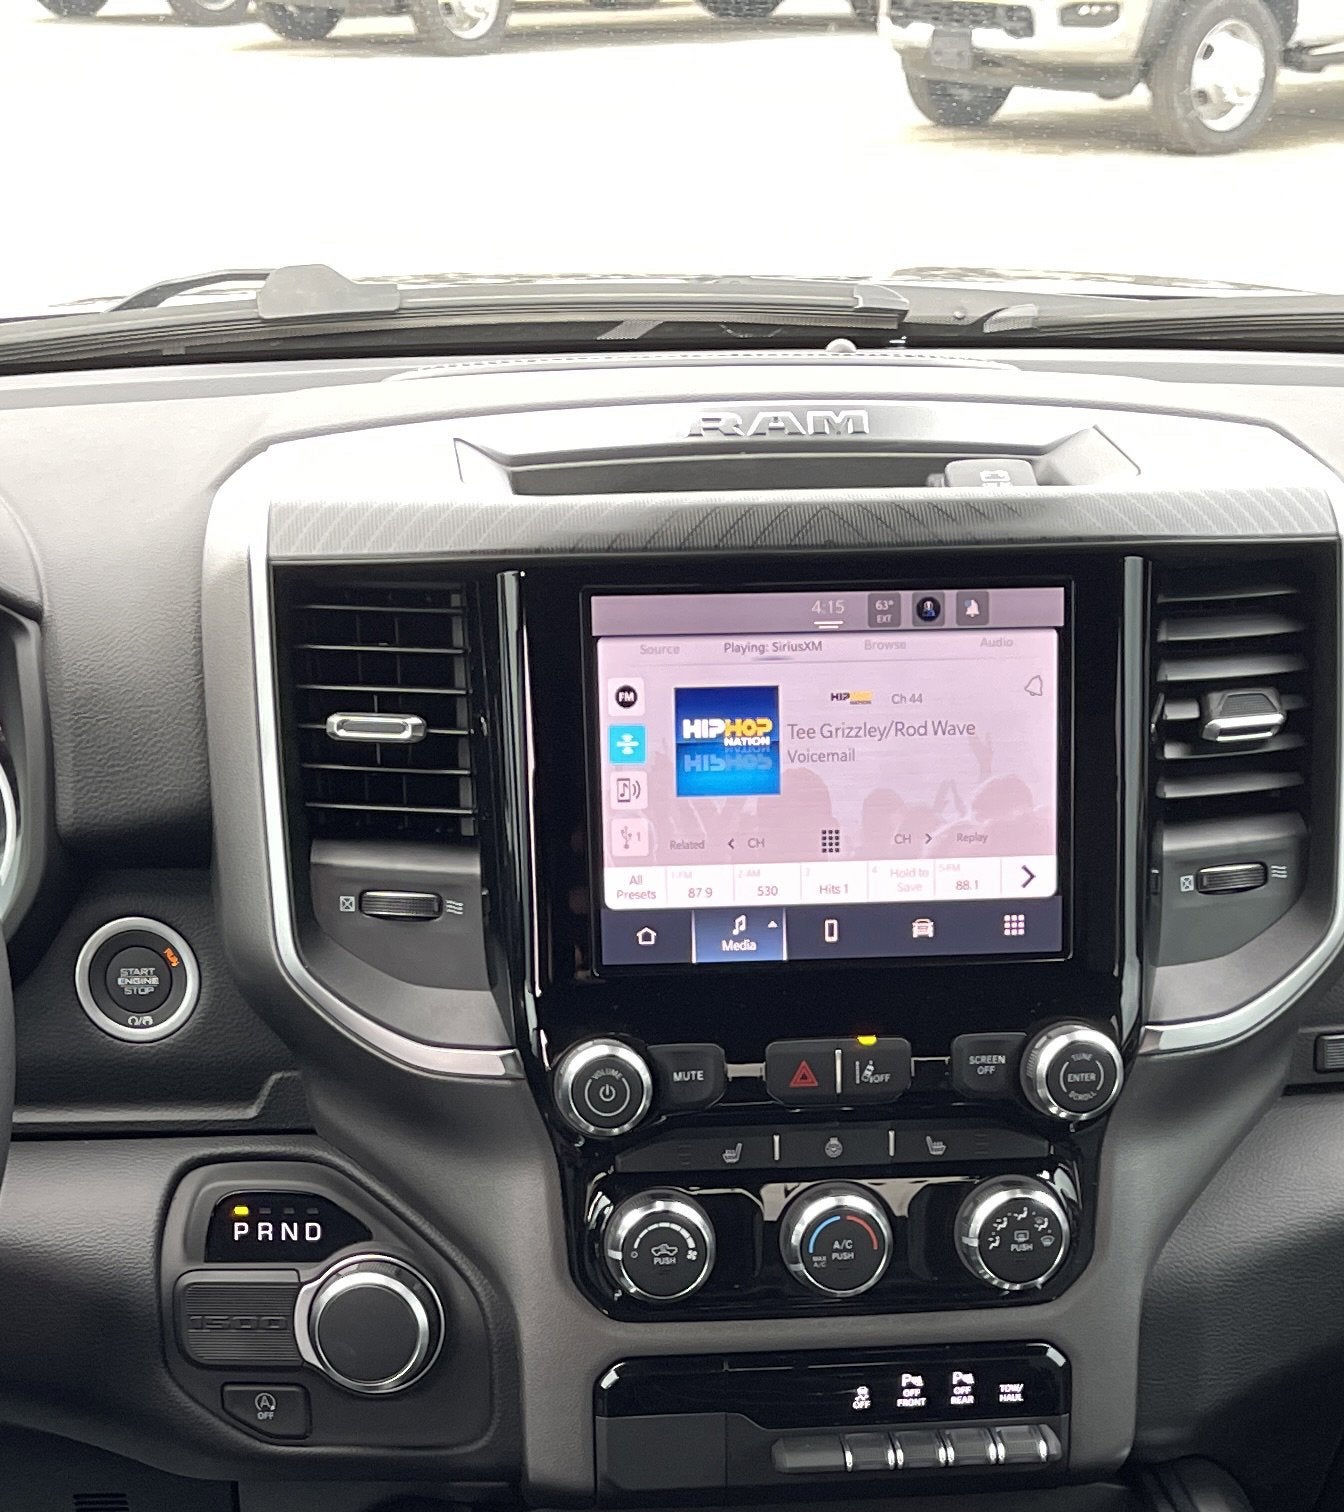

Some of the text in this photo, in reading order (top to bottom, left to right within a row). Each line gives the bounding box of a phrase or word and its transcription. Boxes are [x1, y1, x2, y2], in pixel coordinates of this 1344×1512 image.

[687, 409, 871, 437] RAM
[811, 599, 845, 615] 4:15
[876, 614, 892, 624] EXT
[723, 640, 824, 656] Playing: SiriusXM
[864, 639, 907, 651] Browse
[980, 636, 1014, 649] Audio
[639, 643, 681, 656] Source
[618, 690, 637, 702] FM
[891, 692, 924, 705] Ch 44
[787, 719, 977, 742] Tee Grizzley/Rod Wave
[723, 735, 771, 747] NATION
[787, 748, 856, 764] Voicemail
[747, 837, 766, 849] CH
[894, 833, 912, 845] CH
[956, 832, 988, 844] Replay
[669, 839, 706, 851] Related
[889, 867, 930, 879] Hold to
[628, 875, 644, 886] All
[896, 881, 923, 892] Save
[955, 879, 979, 891] 88.1
[616, 888, 657, 901] Presets
[757, 885, 779, 897] 530
[819, 883, 841, 895] Hits
[721, 938, 757, 952] Media
[119, 967, 156, 978] START
[117, 977, 160, 986] ENGINE
[123, 986, 155, 996] STOP
[968, 1055, 1006, 1066] SCREEN
[591, 1068, 623, 1081] VOLUME
[672, 1070, 705, 1082] MUTE
[976, 1065, 996, 1075] OFF
[1067, 1072, 1097, 1083] ENTER
[1067, 1090, 1098, 1101] SCROLL
[833, 1239, 853, 1250] A/C
[1010, 1243, 1034, 1252] PUSH
[653, 1256, 676, 1265] PUSH
[831, 1251, 855, 1261] PUSH
[189, 1315, 289, 1331] 1500
[902, 1388, 921, 1397] OFF
[953, 1386, 972, 1395] OFF
[896, 1397, 927, 1407] FRONT
[950, 1395, 975, 1405] REAR
[999, 1393, 1024, 1402] HAUL
[852, 1400, 871, 1409] OFF
[257, 1411, 274, 1420] OFF
